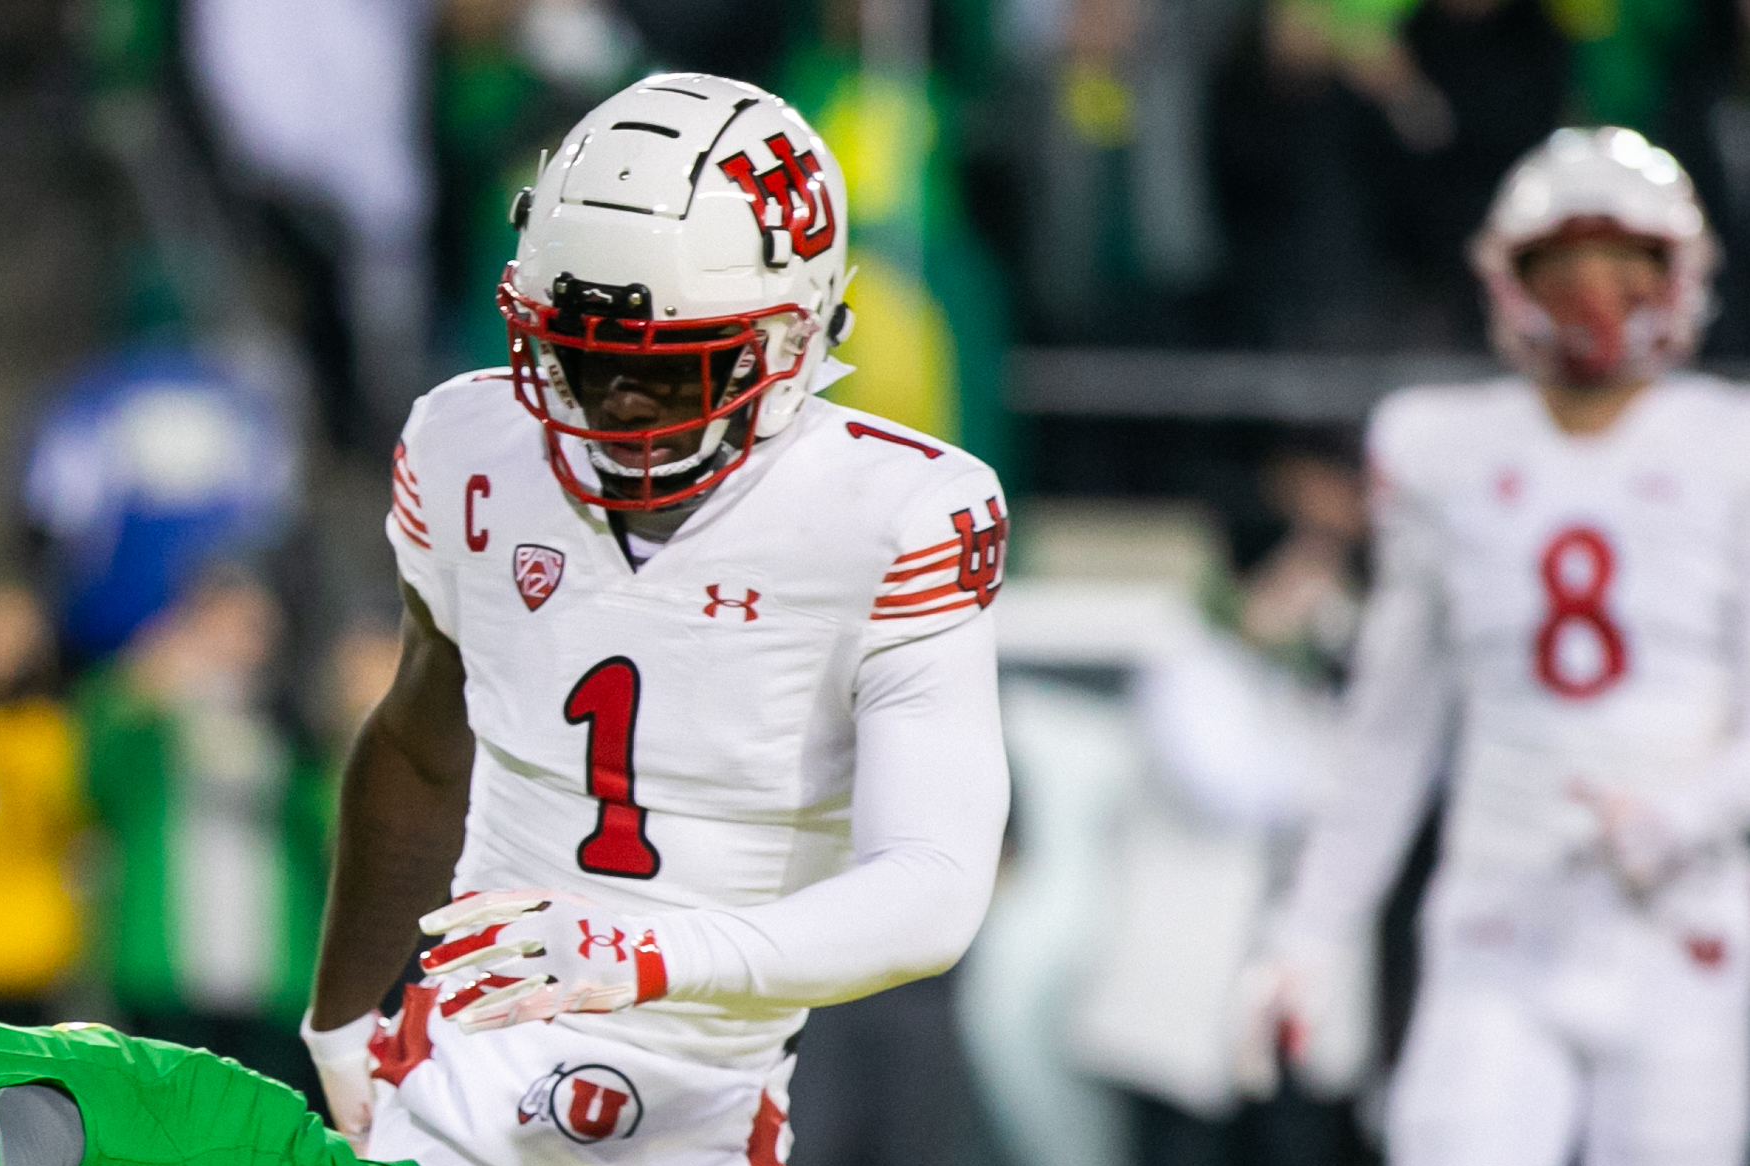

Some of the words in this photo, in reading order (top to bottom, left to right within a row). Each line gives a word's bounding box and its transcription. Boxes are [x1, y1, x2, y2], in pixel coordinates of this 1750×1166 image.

[846, 421, 945, 460] 1
[464, 474, 491, 553] C
[1531, 524, 1629, 705] 8
[563, 654, 661, 880] 1
[568, 1077, 630, 1141] U
